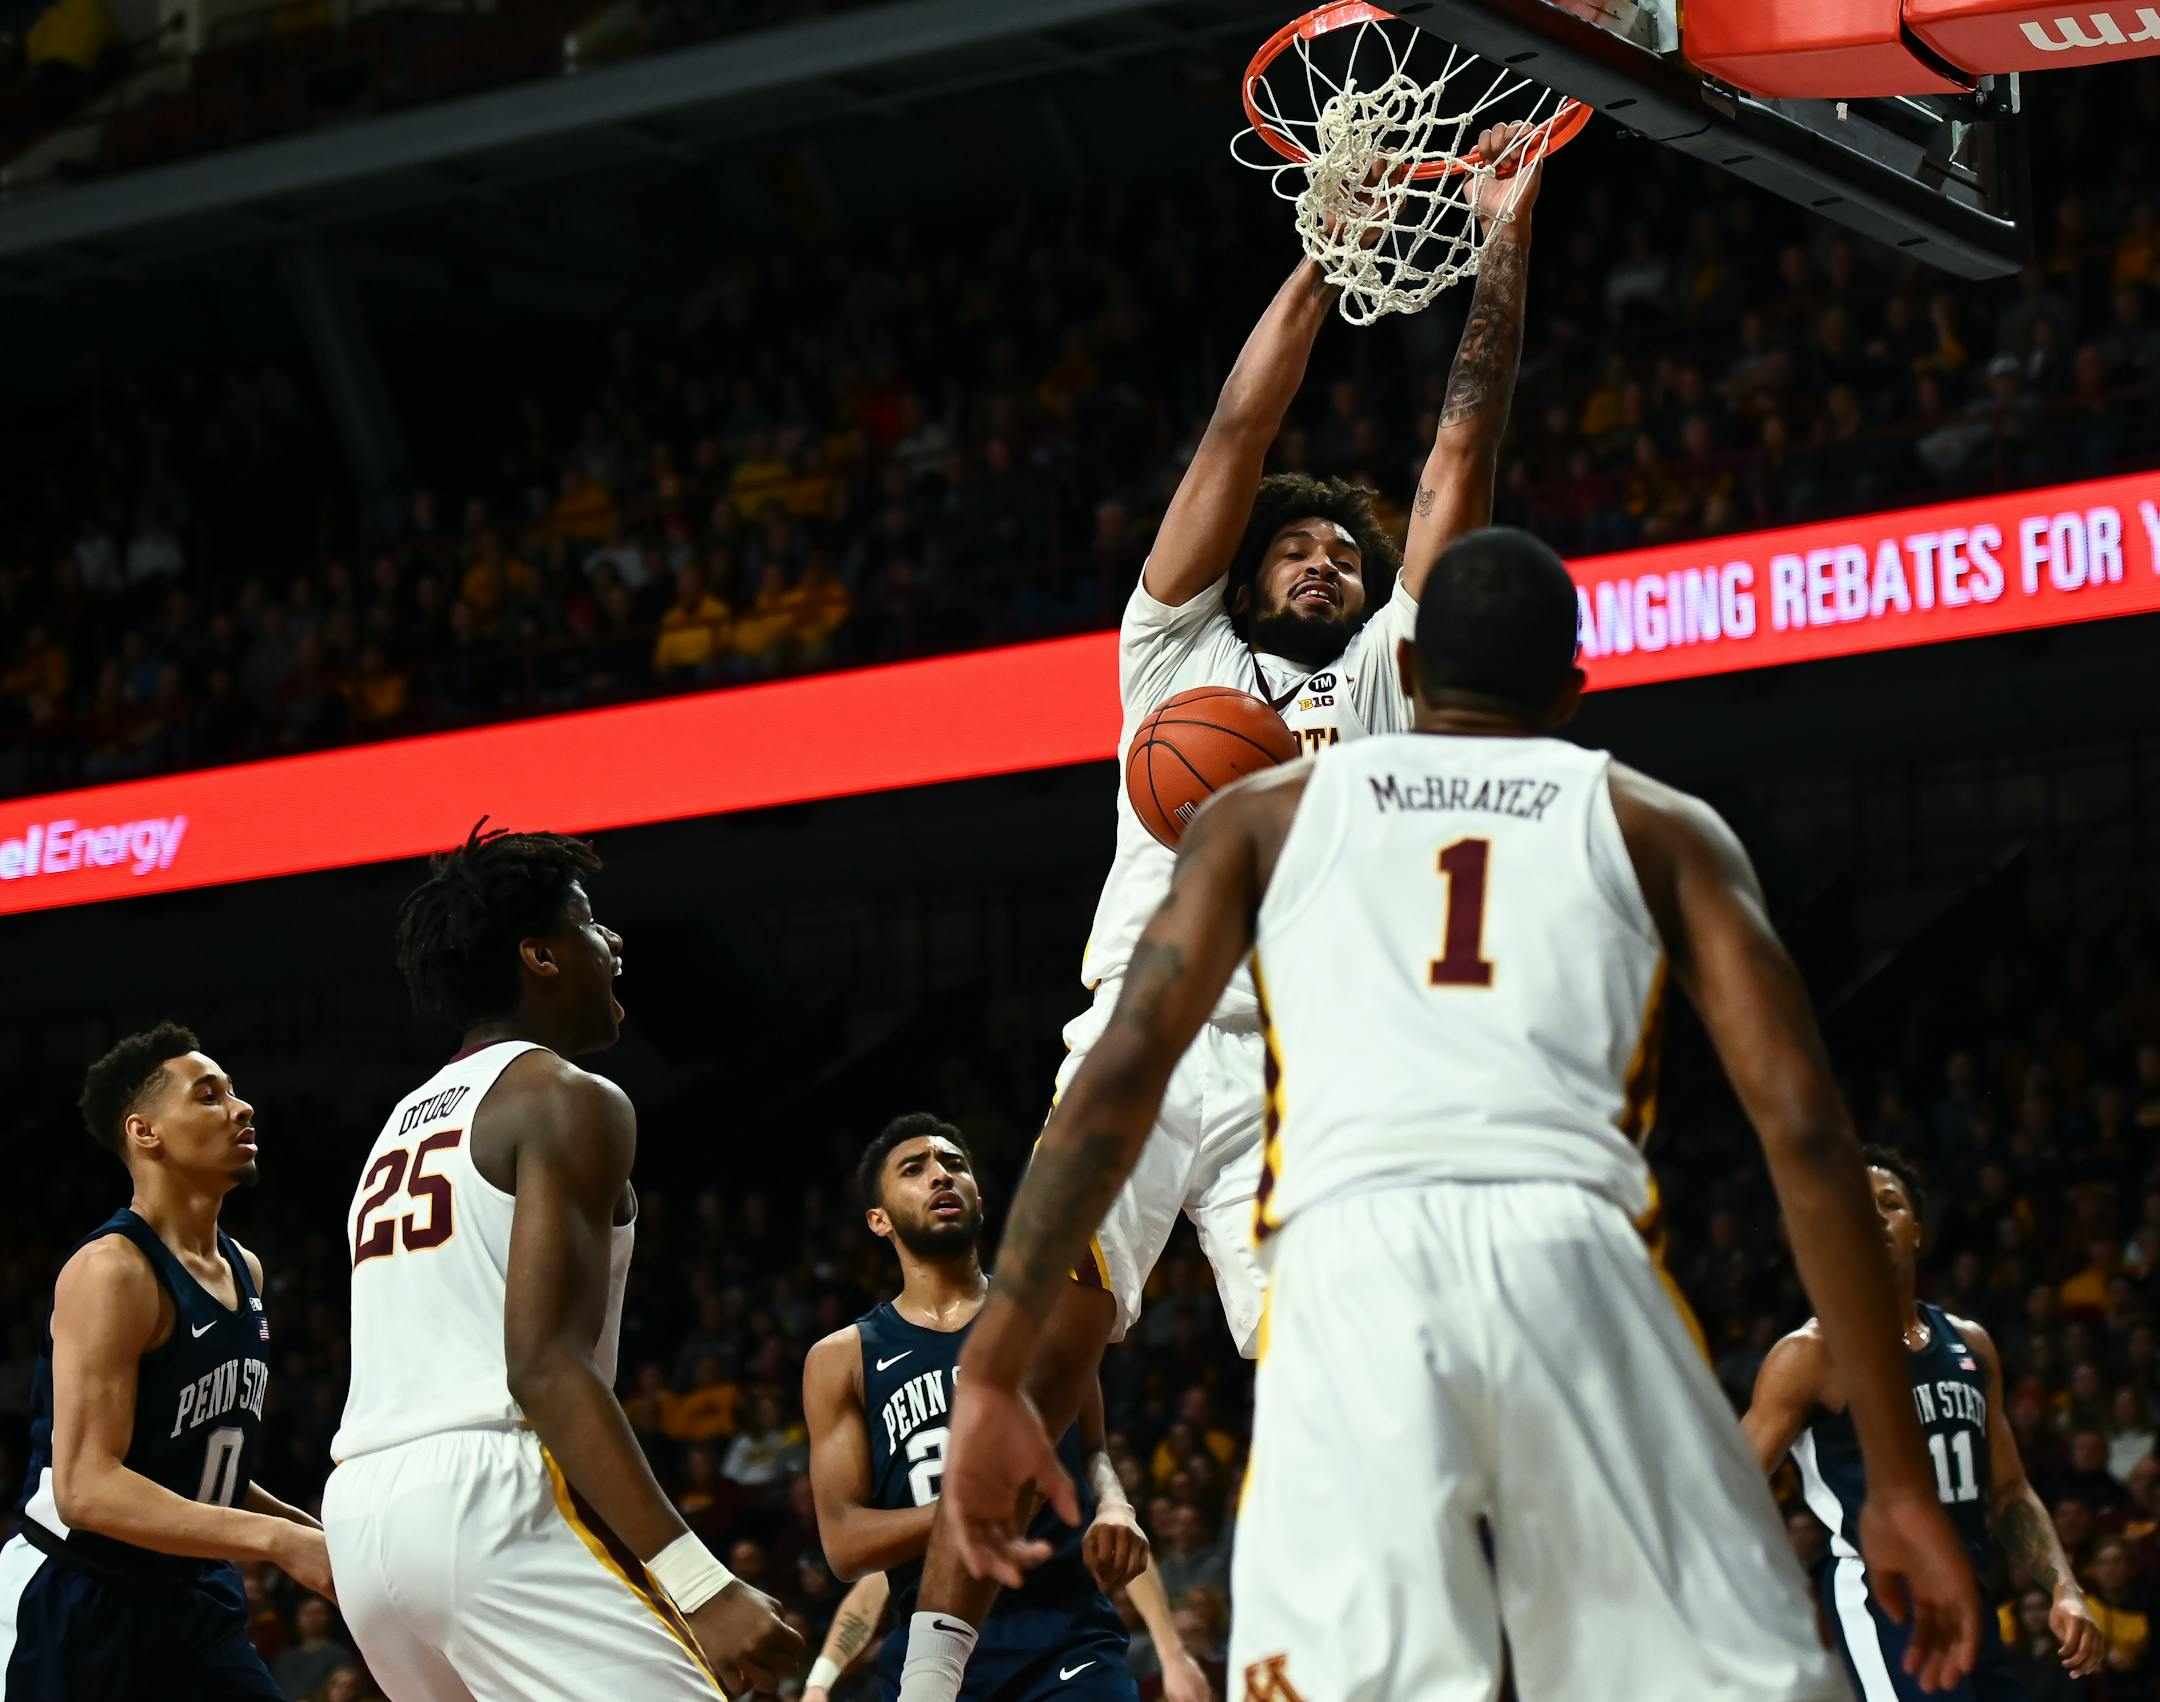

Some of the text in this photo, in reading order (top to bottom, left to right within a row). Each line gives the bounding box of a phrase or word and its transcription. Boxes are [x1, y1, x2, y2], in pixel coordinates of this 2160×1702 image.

[1770, 523, 2005, 632] REBATES
[2019, 505, 2124, 595] FOR
[1368, 774, 1561, 822] McBRAYER
[1427, 835, 1496, 990] 1
[398, 1085, 471, 1137] OTURU
[352, 1128, 465, 1269] 25
[169, 1358, 239, 1439] PENN
[881, 1369, 948, 1457] PENN
[196, 1425, 245, 1508] 0
[1927, 1430, 1980, 1505] 11
